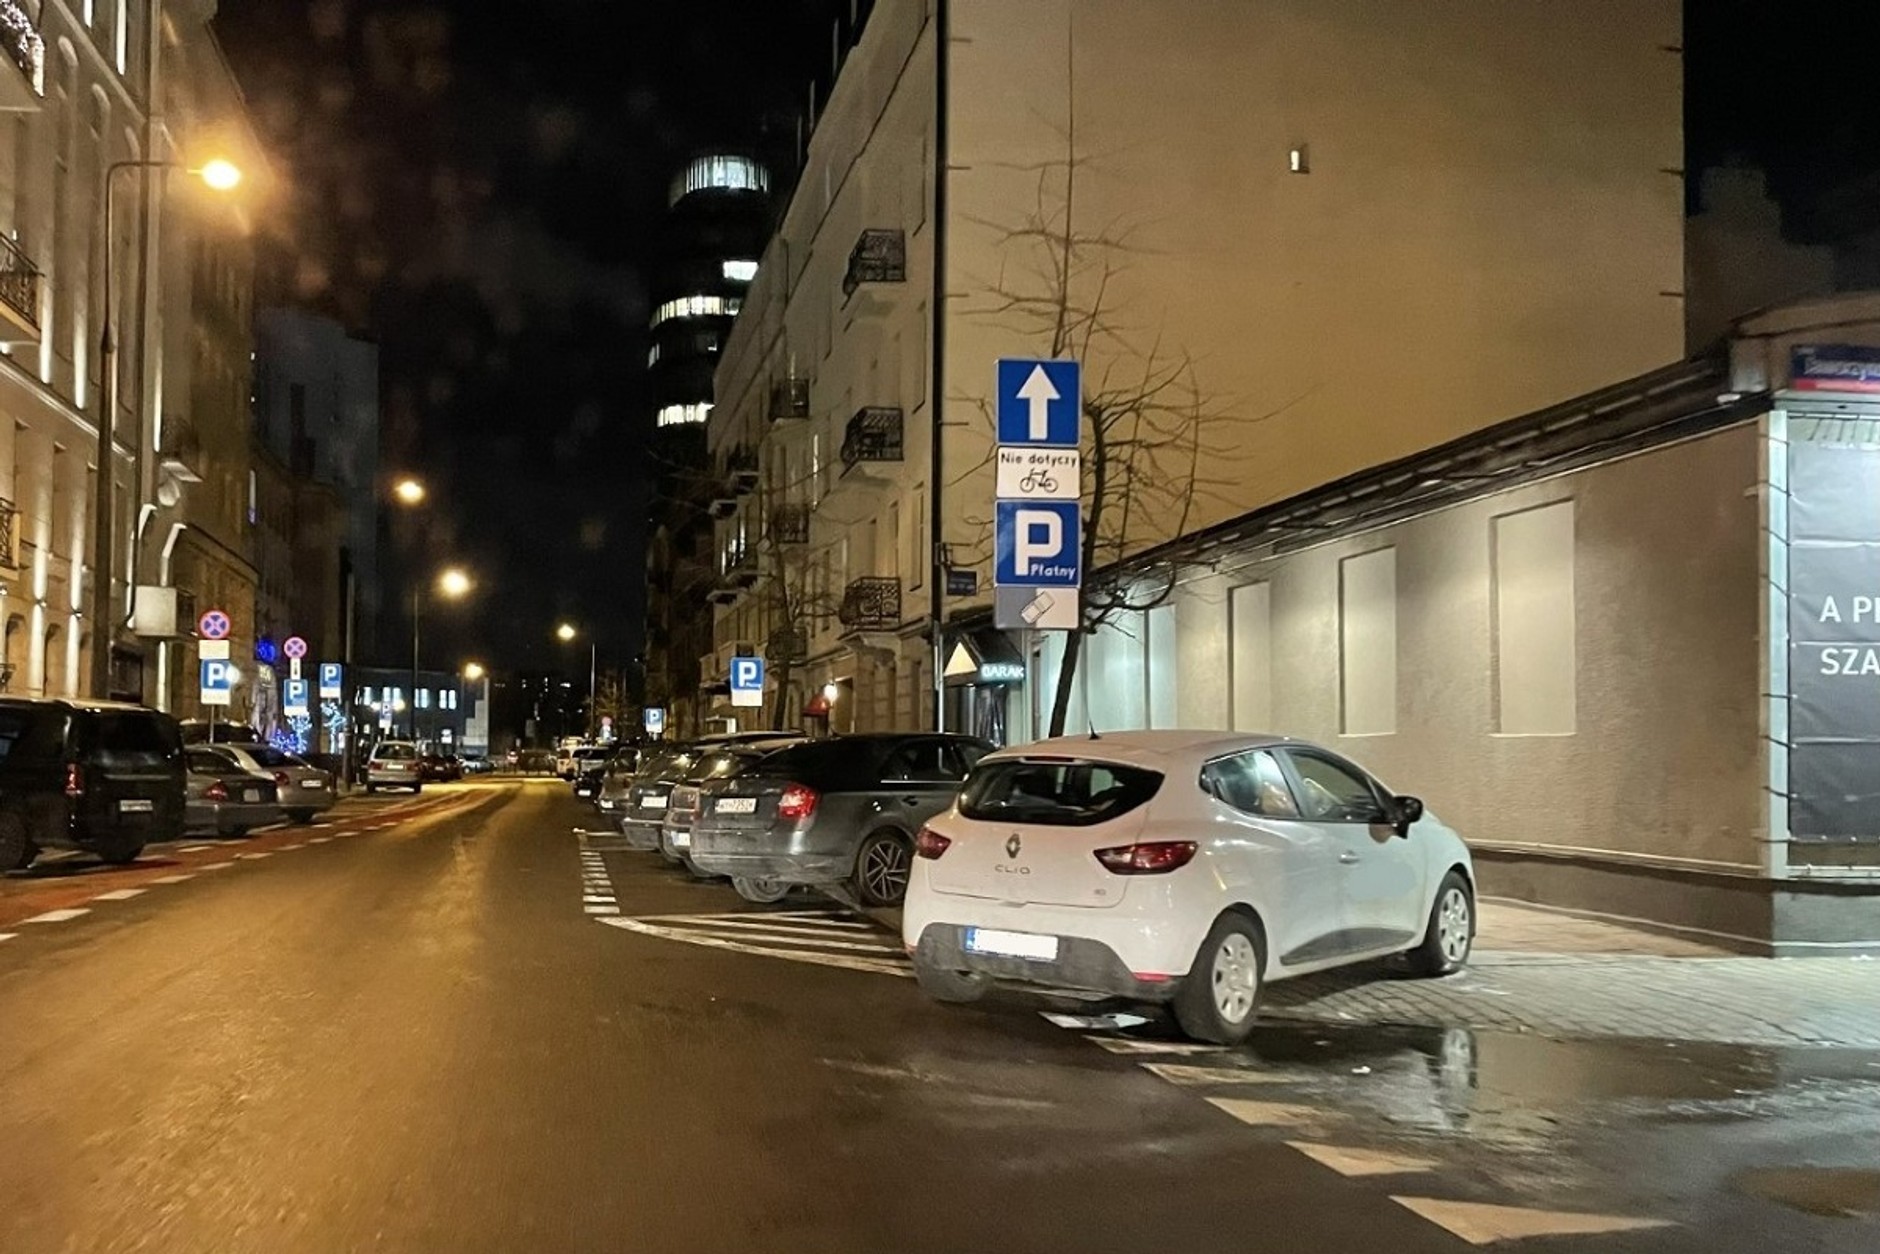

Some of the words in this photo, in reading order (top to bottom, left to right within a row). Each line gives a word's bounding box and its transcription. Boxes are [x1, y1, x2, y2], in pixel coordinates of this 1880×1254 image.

[1001, 453, 1021, 464] Nie
[1029, 454, 1077, 467] dotyczy
[1015, 509, 1062, 576] P
[1819, 595, 1841, 622] A
[208, 663, 225, 687] P
[324, 666, 337, 681] P
[738, 661, 757, 687] P
[289, 683, 302, 699] P
[994, 864, 1031, 875] CLIO
